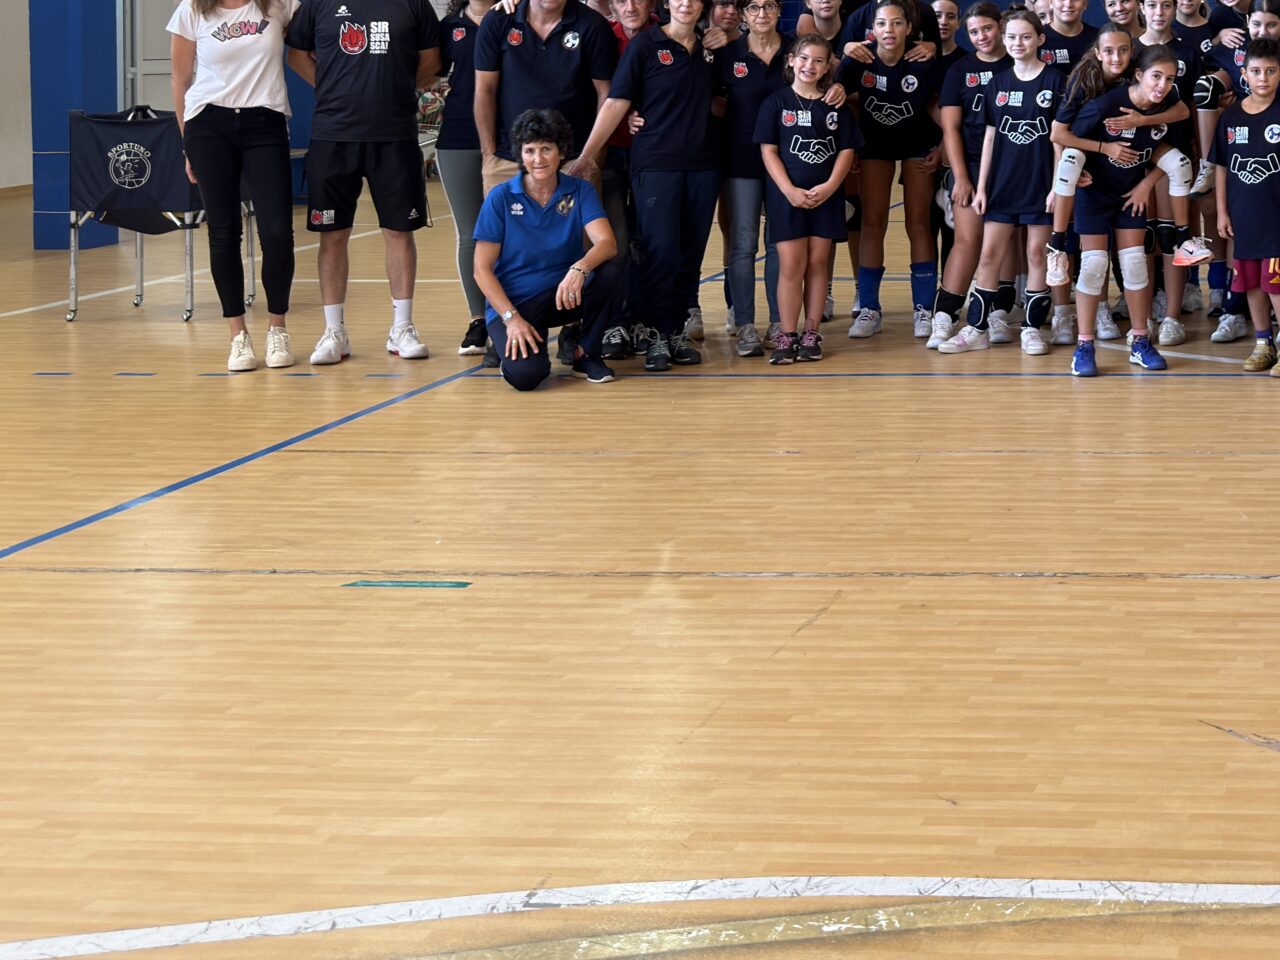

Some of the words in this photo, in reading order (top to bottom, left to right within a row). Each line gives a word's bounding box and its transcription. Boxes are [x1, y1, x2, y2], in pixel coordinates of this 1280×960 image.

[370, 21, 389, 33] SIR
[370, 33, 390, 42] SUSA
[370, 41, 388, 50] SCAI
[1010, 91, 1023, 99] SIR
[1236, 126, 1248, 135] SIR
[108, 143, 152, 158] SPORTUNO
